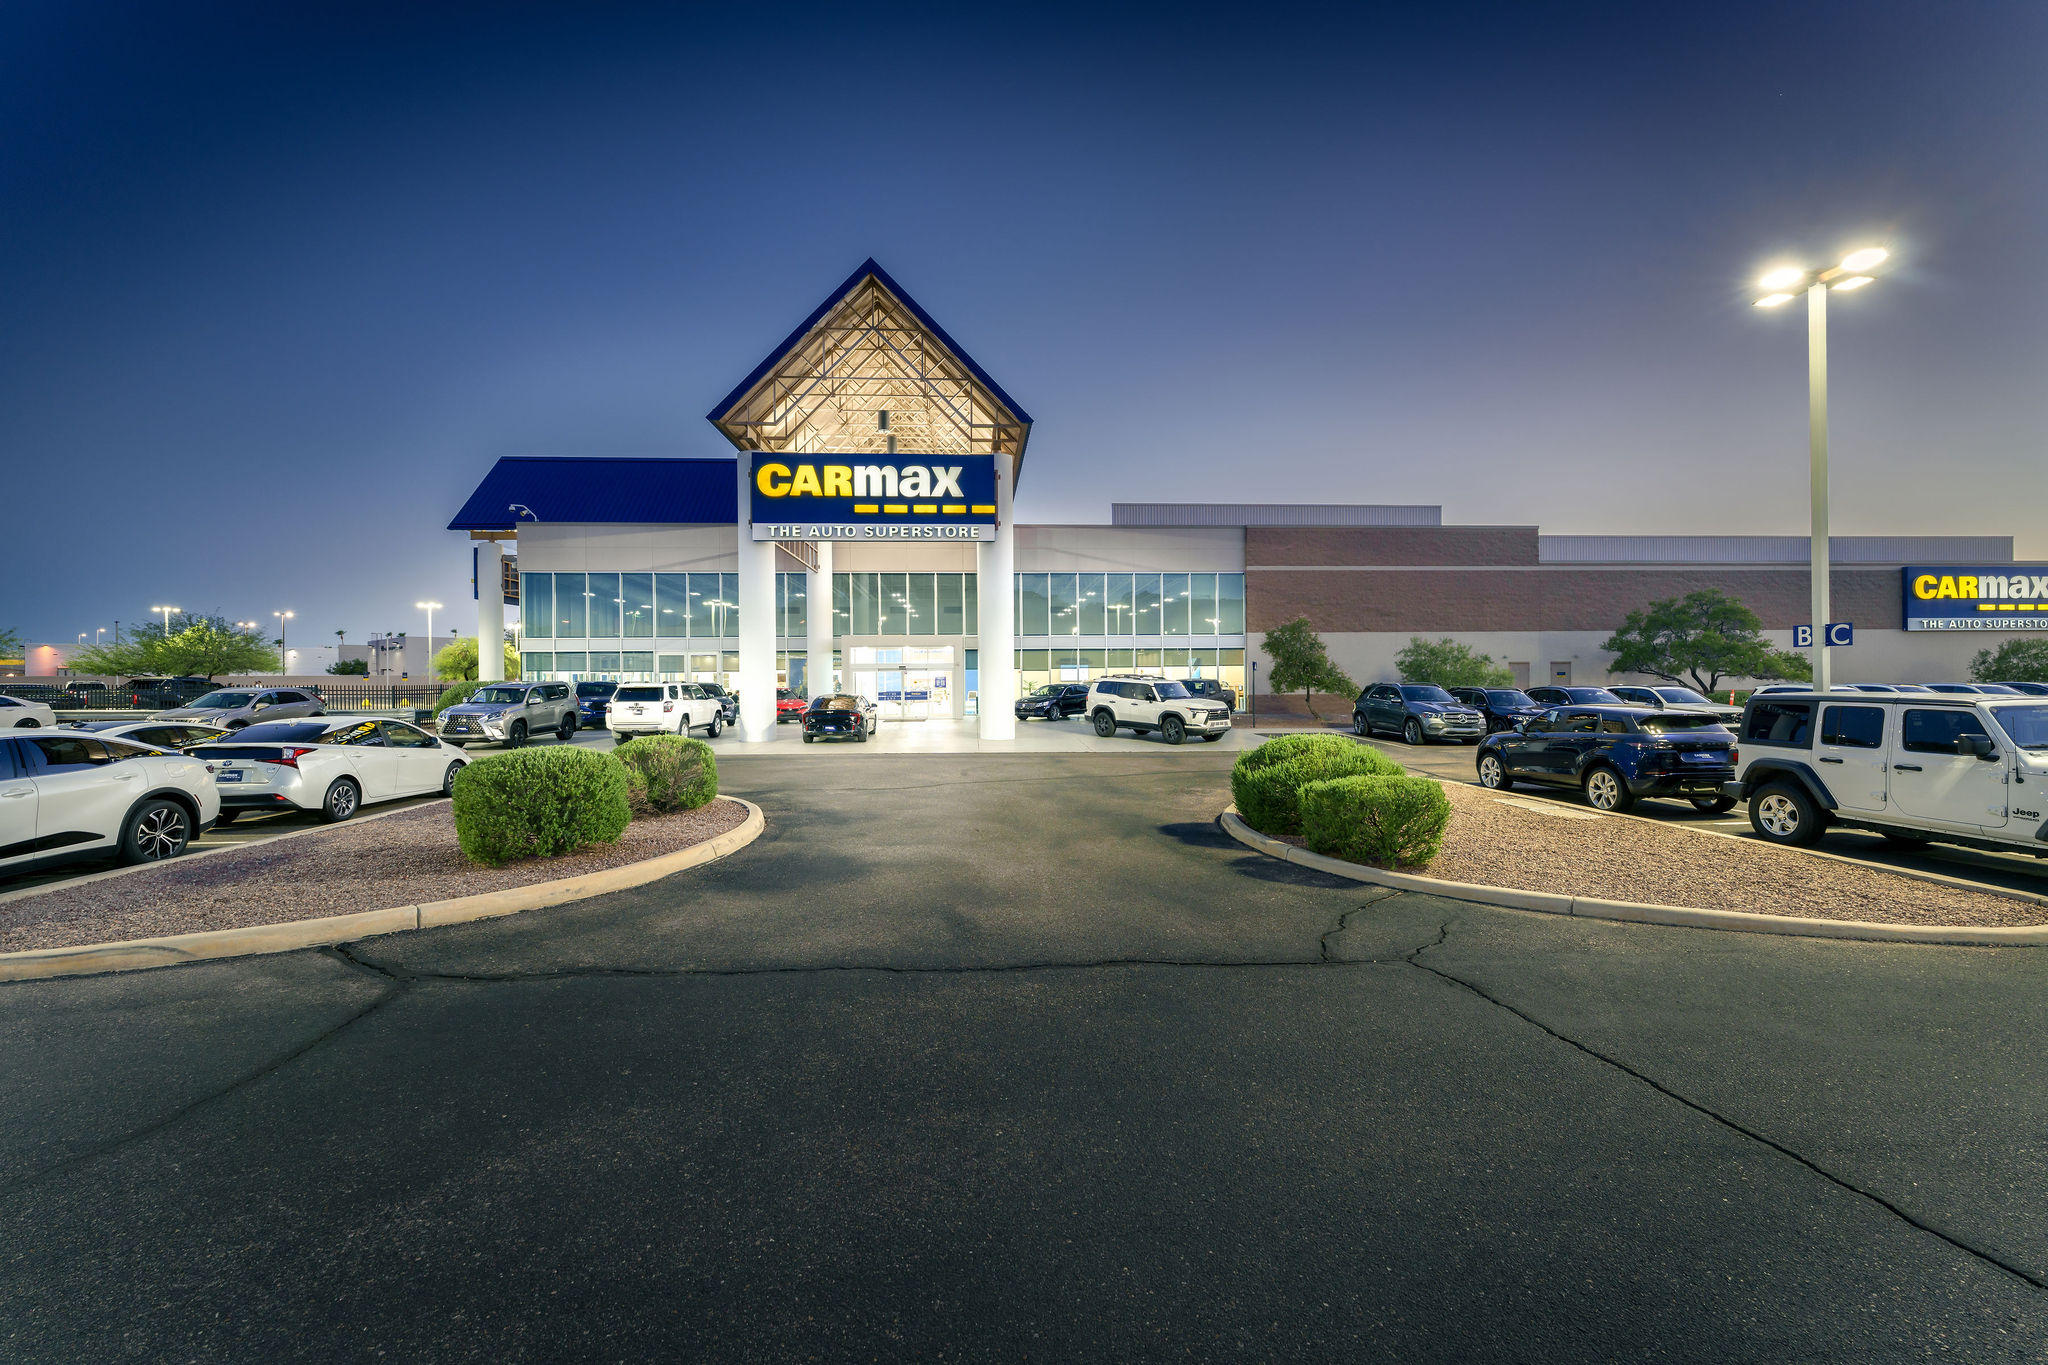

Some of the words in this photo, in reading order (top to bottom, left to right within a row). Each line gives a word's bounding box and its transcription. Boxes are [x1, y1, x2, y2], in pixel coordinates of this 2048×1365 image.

[767, 525, 802, 538] THE
[809, 525, 857, 538] AUTO
[864, 526, 980, 539] SUPERSTORE
[1922, 620, 1944, 629] THE
[1949, 620, 1981, 629] AUTO
[1797, 626, 1812, 646] B
[1830, 623, 1850, 645] C
[2012, 807, 2040, 819] Jeep
